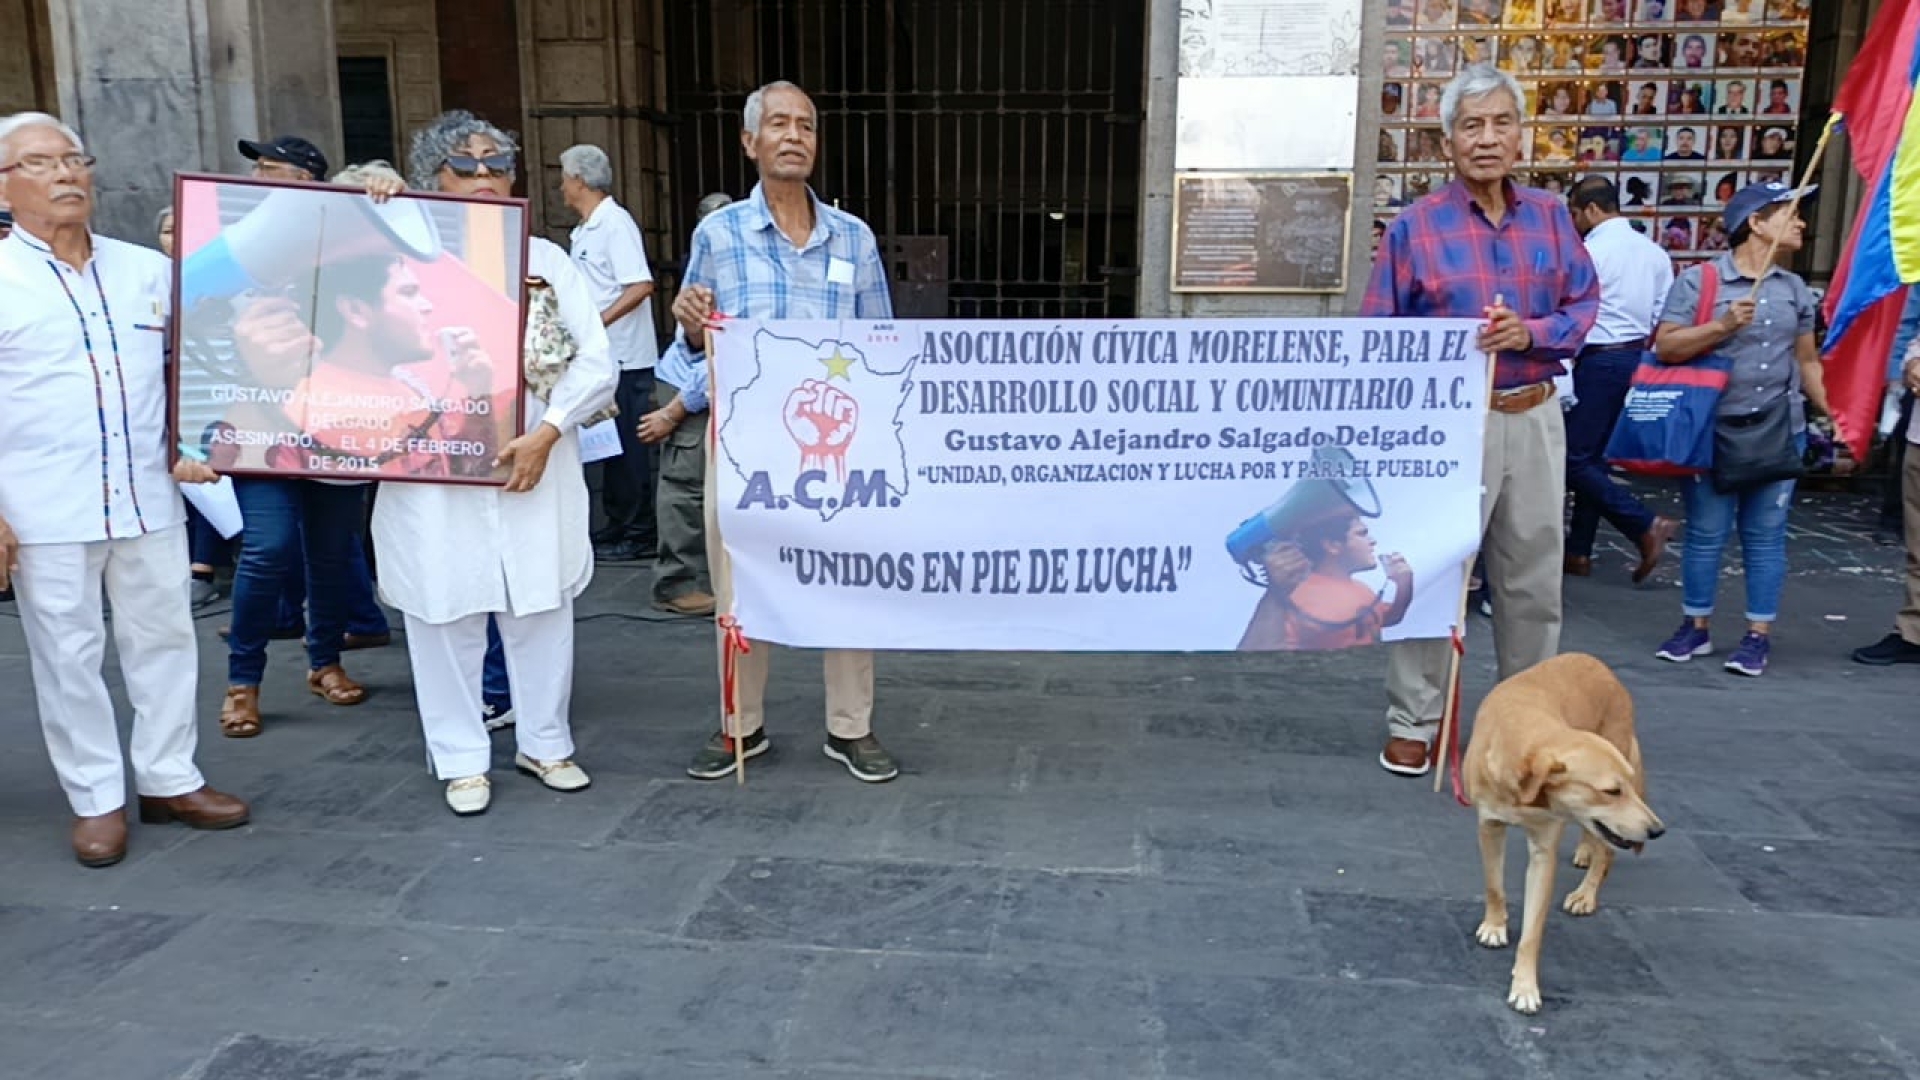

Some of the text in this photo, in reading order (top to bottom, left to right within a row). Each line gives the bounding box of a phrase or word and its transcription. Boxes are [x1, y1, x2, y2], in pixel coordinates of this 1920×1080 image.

[920, 325, 1469, 367] ASOCIACIÓN CÍVICA MORELENSE, PARA EL
[210, 386, 296, 405] GUSTAVO
[411, 396, 489, 415] SALGADO
[919, 375, 1472, 414] DESARROLLO SOCIAL Y COMUNITARIO A.C.
[309, 414, 393, 430] DELGADO
[341, 437, 361, 450] EL
[365, 438, 376, 450] 4
[381, 437, 403, 451] DE
[407, 439, 486, 456] FEBRERO
[944, 425, 1446, 455] Gustavo Alejandro Salgado Delgado
[309, 455, 330, 470] DE
[917, 459, 1459, 486] “UNIDAD, ORGANIZACION Y LUCHA POR Y PARA EL PUEBLO”
[736, 469, 902, 510] A.C.M.
[779, 545, 1193, 595] “UNIDOS EN PIE DE LUCHA”
